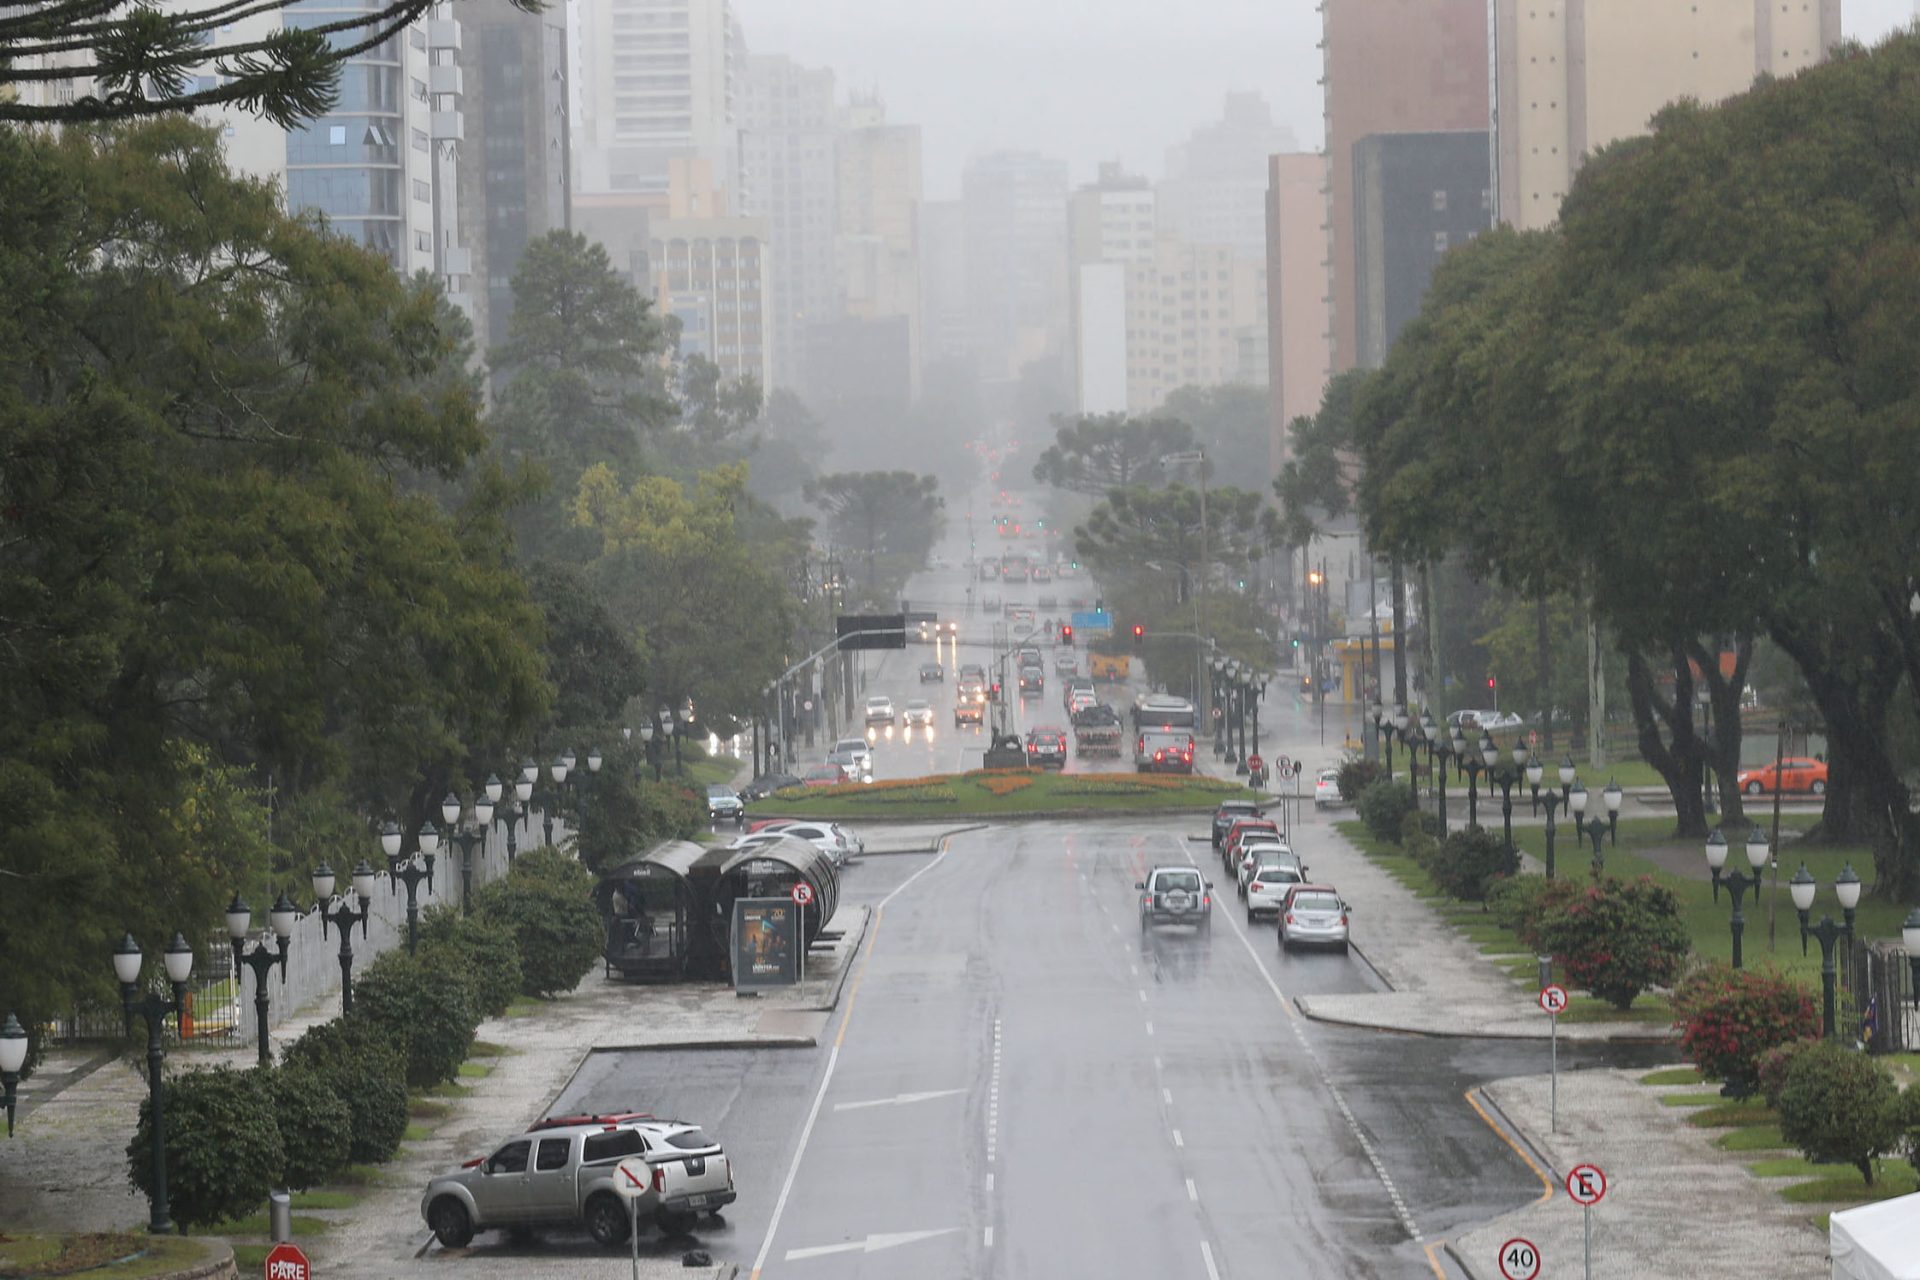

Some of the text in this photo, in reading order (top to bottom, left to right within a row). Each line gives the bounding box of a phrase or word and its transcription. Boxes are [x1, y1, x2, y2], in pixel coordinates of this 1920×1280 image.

[1548, 990, 1559, 1007] E
[1579, 1172, 1594, 1196] E
[1507, 1248, 1533, 1268] 40
[270, 1261, 305, 1280] PARE
